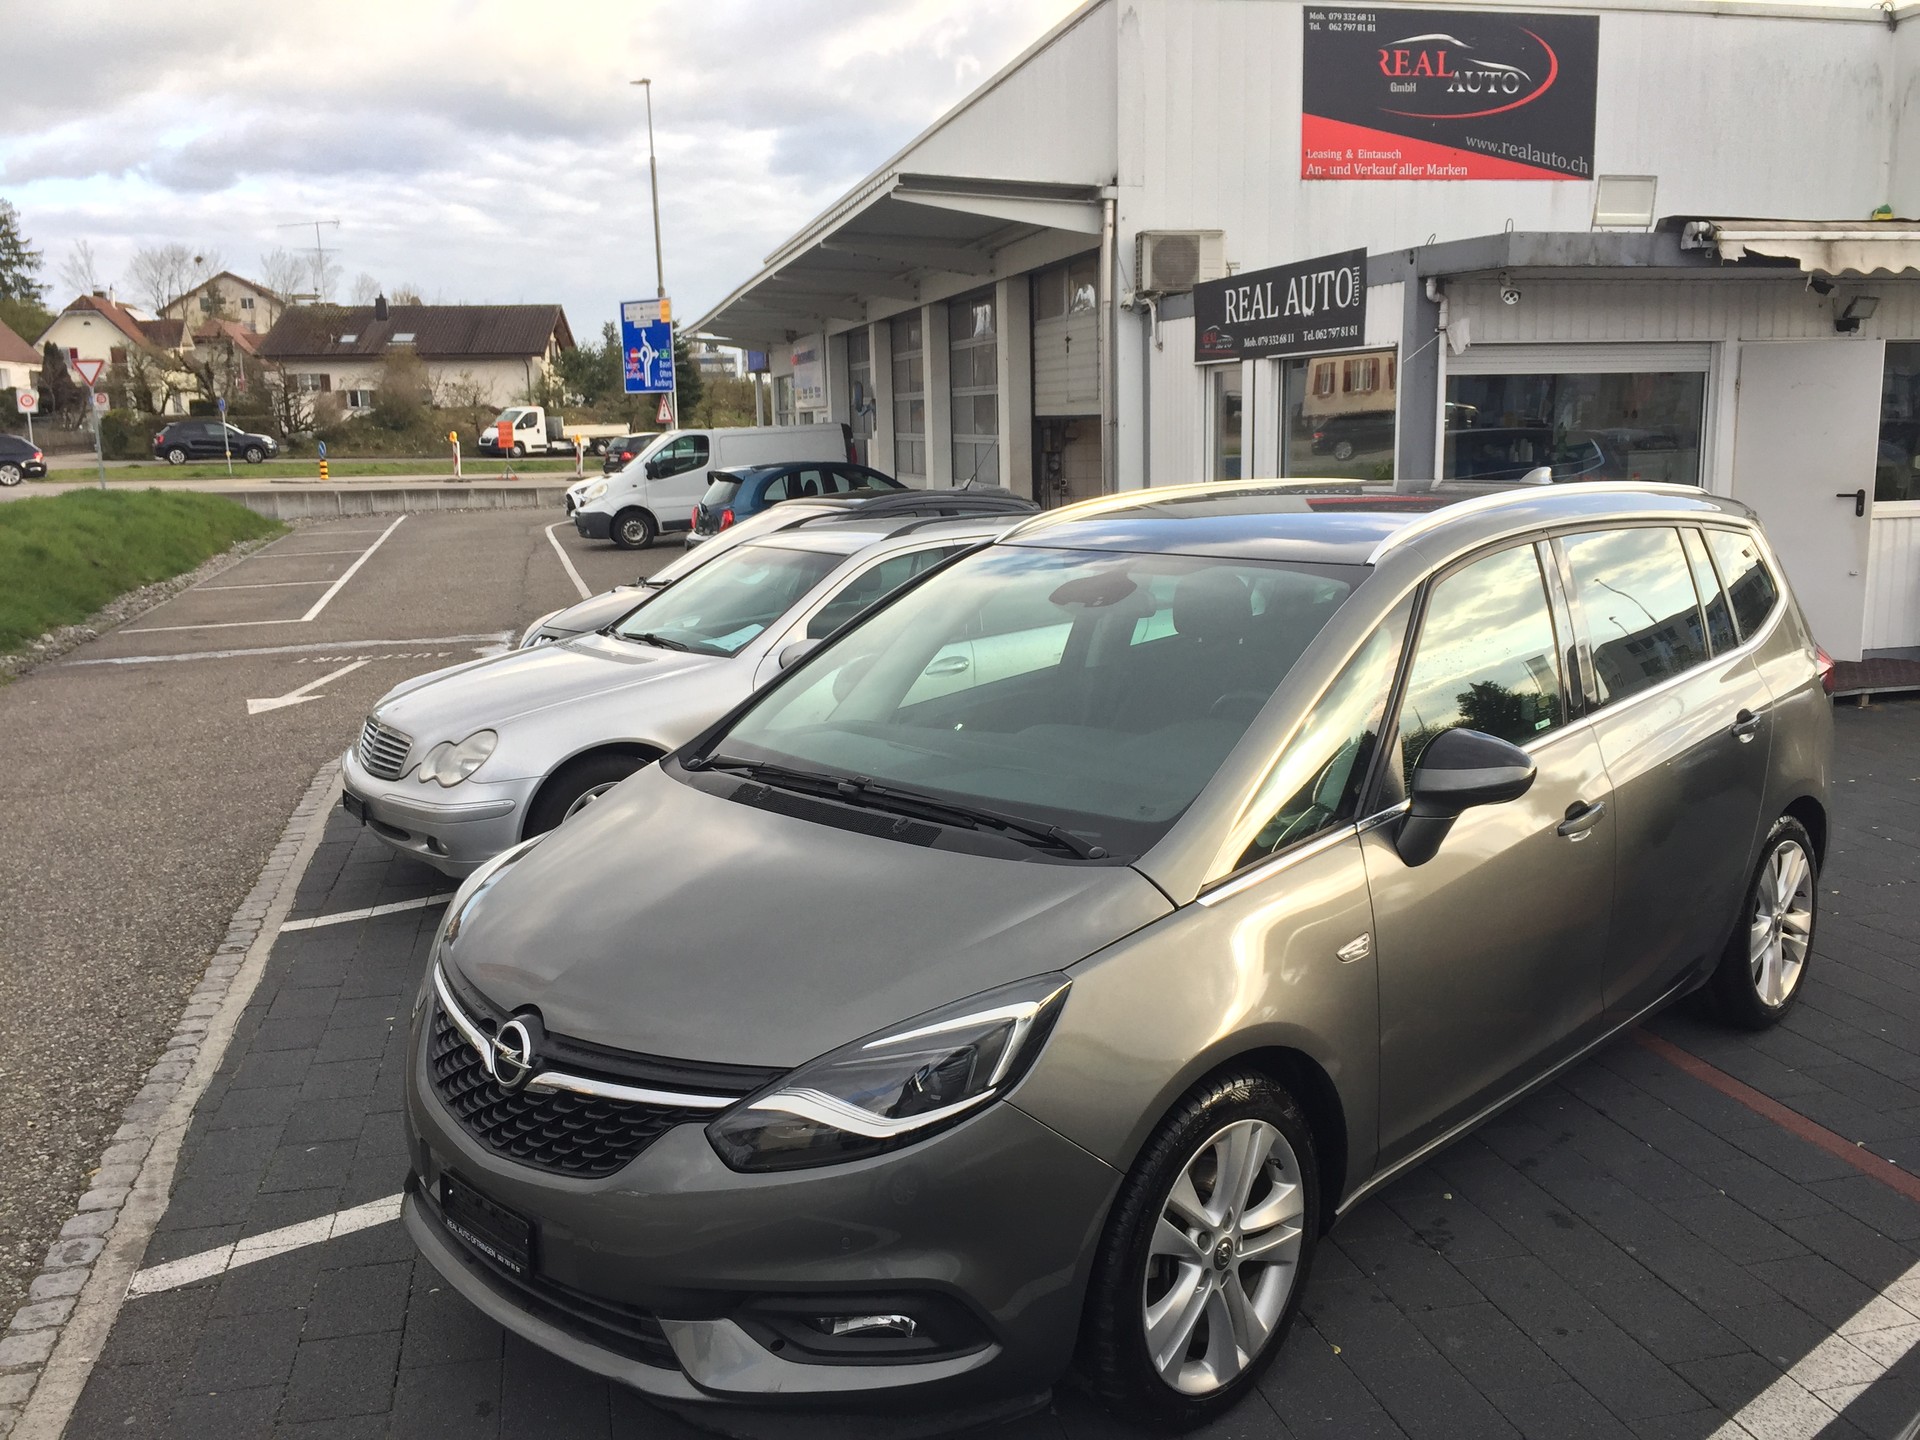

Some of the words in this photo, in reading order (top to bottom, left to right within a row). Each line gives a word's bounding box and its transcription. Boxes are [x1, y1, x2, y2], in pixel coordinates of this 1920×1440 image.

[1309, 12, 1326, 20] Mob.
[1328, 12, 1342, 20] 079
[1343, 13, 1356, 21] 332
[1357, 13, 1367, 21] 68
[1309, 22, 1321, 30] Tel.
[1328, 23, 1342, 31] 062
[1343, 23, 1356, 31] 797
[1378, 49, 1454, 77] REAL
[1390, 82, 1417, 92] GmbH
[1447, 71, 1520, 94] AUTO
[1307, 149, 1342, 160] Leasing
[1345, 149, 1353, 159] &
[1358, 149, 1402, 159] Eintausch
[1465, 135, 1589, 174] www.realauto.ch
[1306, 164, 1326, 175] An-
[1330, 164, 1351, 175] und
[1354, 163, 1398, 175] Verkauf
[1399, 164, 1424, 175] aller
[1427, 164, 1468, 175] Marken
[1352, 266, 1360, 307] GmbH
[1225, 282, 1278, 324] REAL
[1284, 267, 1353, 316] AUTO
[1258, 336, 1268, 346] 079
[1268, 335, 1279, 345] 332
[1280, 334, 1287, 343] 68
[1288, 333, 1295, 343] 11
[1303, 330, 1315, 341] Tel.
[1315, 329, 1327, 340] 062
[1328, 327, 1340, 338] 797
[1340, 326, 1349, 337] 81
[1349, 325, 1358, 336] 81
[292, 651, 453, 664] AUSFAHRT
[447, 1219, 458, 1232] REAL
